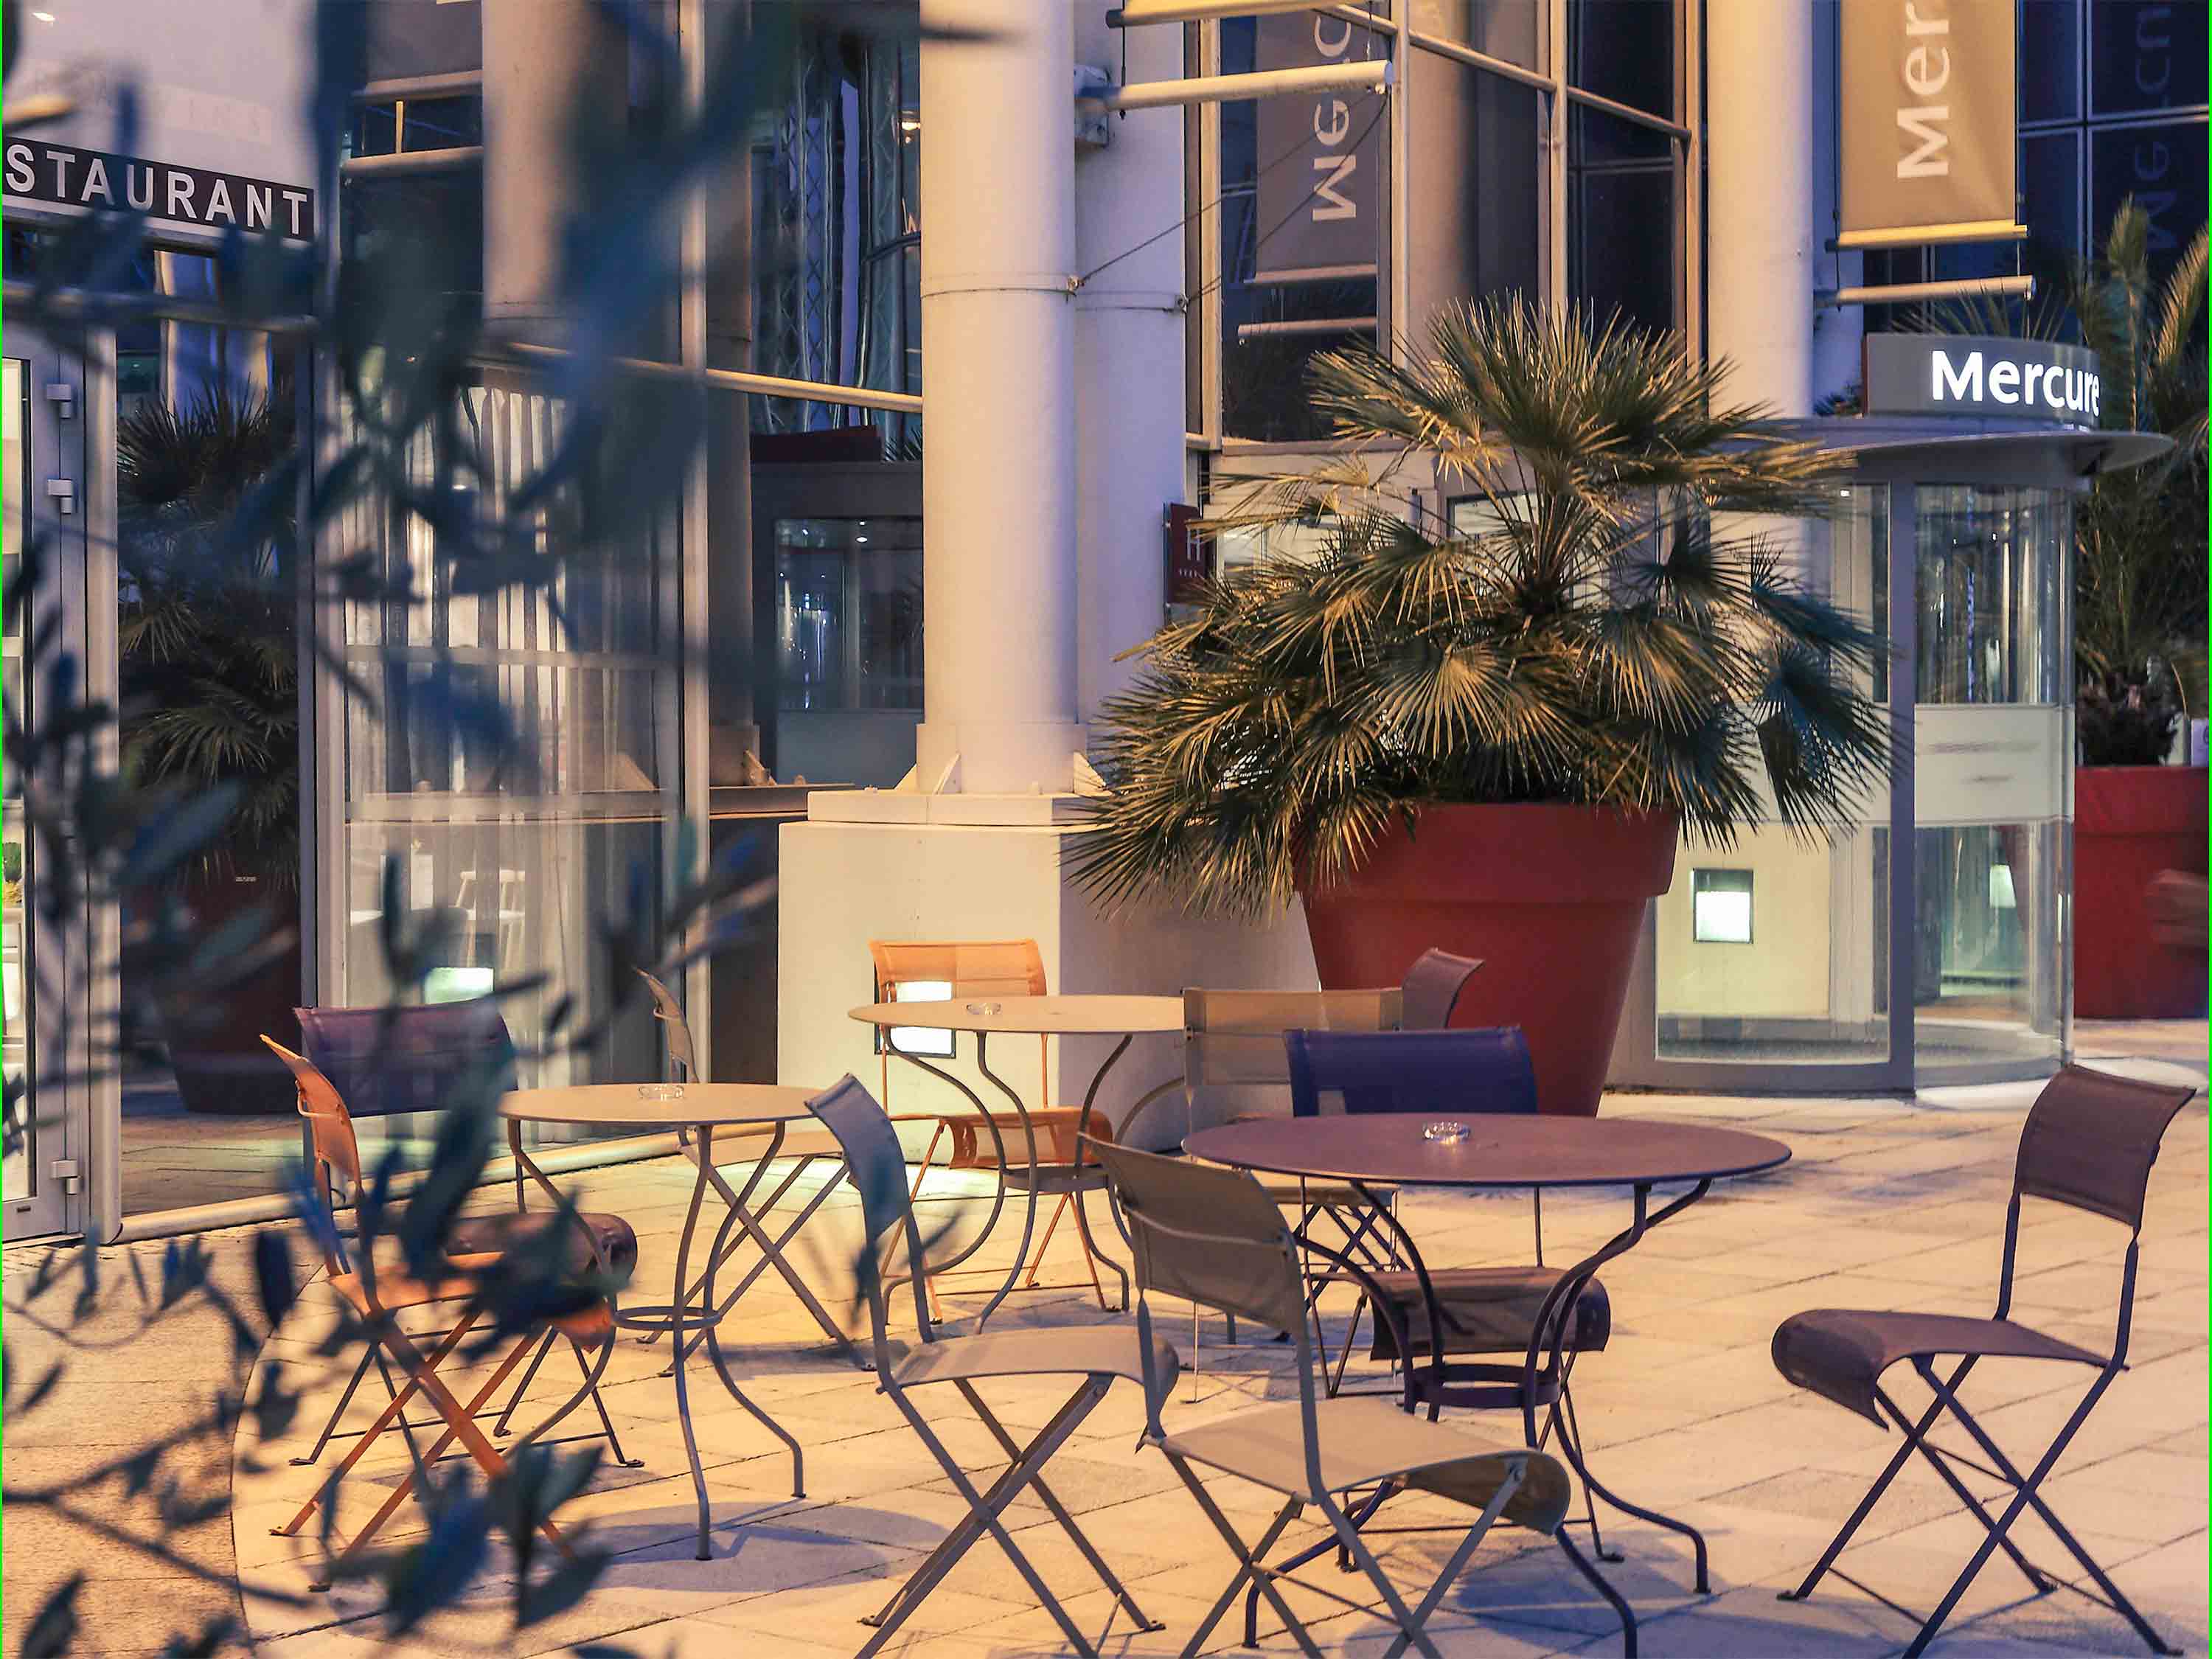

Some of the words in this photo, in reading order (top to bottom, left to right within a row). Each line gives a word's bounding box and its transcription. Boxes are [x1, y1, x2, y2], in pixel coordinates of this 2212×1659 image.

[1896, 1, 1950, 179] Mer
[5, 144, 308, 235] STAURANT
[1932, 350, 2100, 417] Mercure
